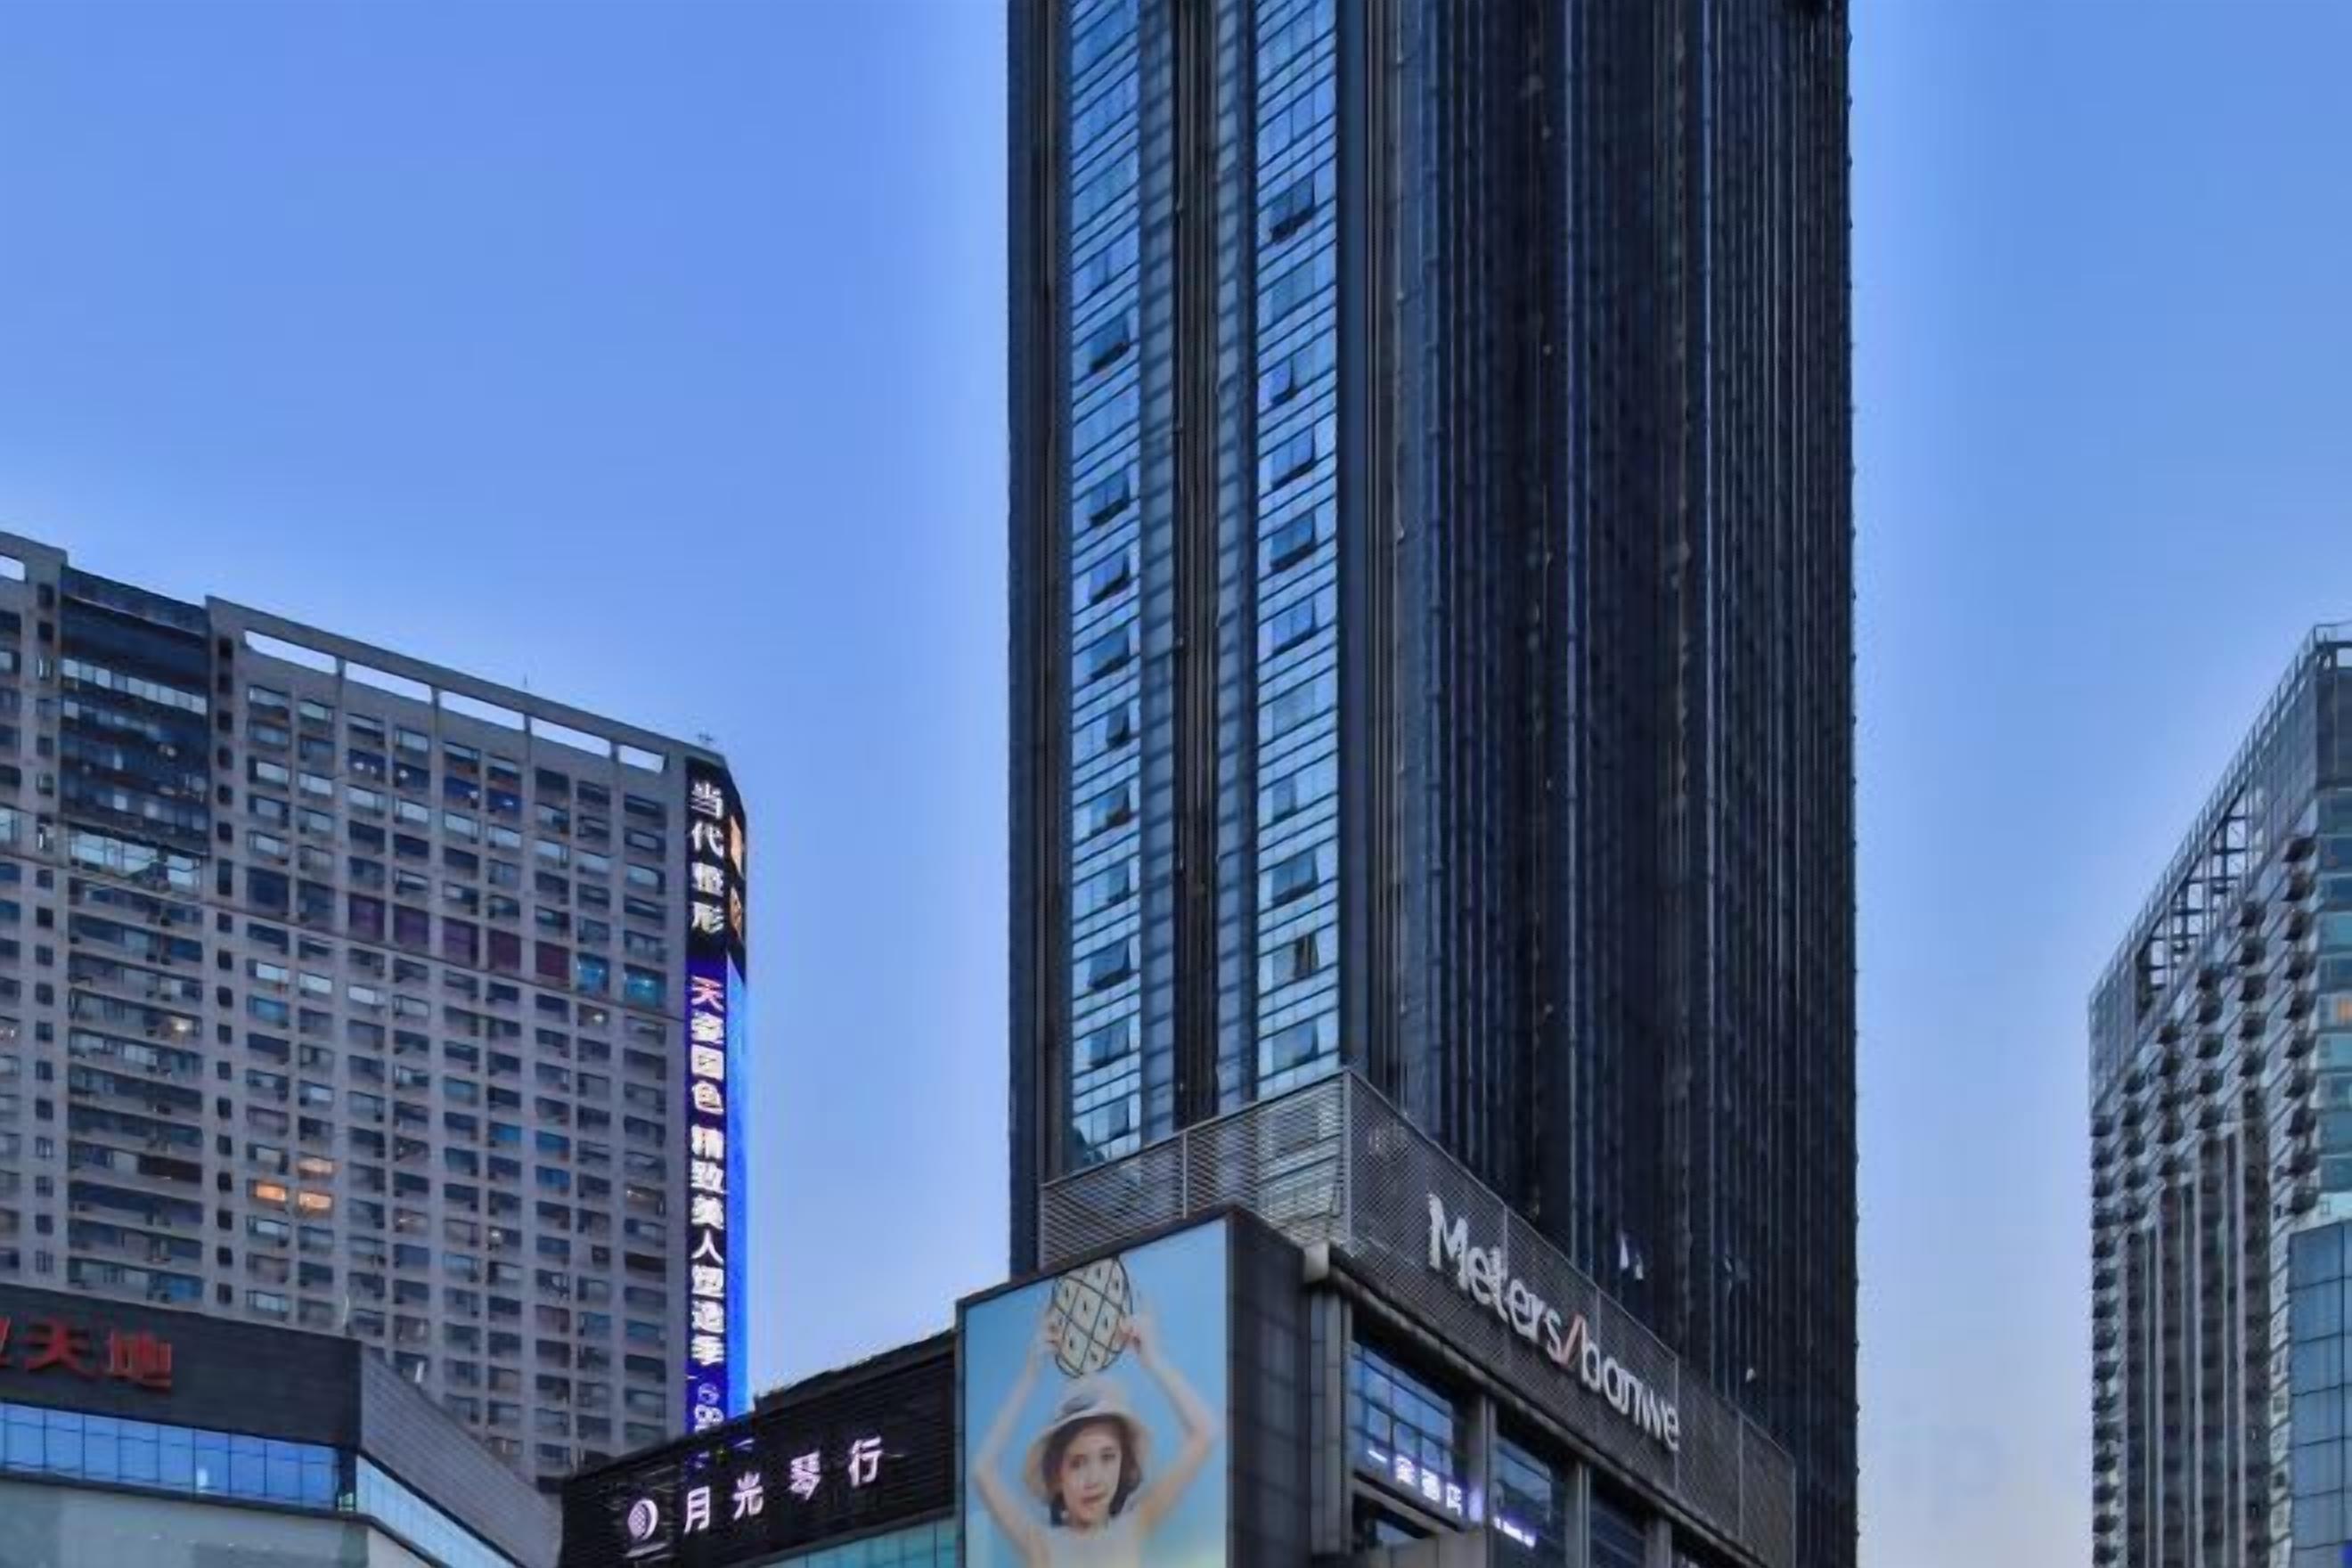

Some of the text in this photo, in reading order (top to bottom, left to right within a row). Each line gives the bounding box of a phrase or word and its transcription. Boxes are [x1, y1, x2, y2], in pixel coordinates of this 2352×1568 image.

[0, 1315, 172, 1390] 天地
[683, 1436, 881, 1535] 月光琴行
